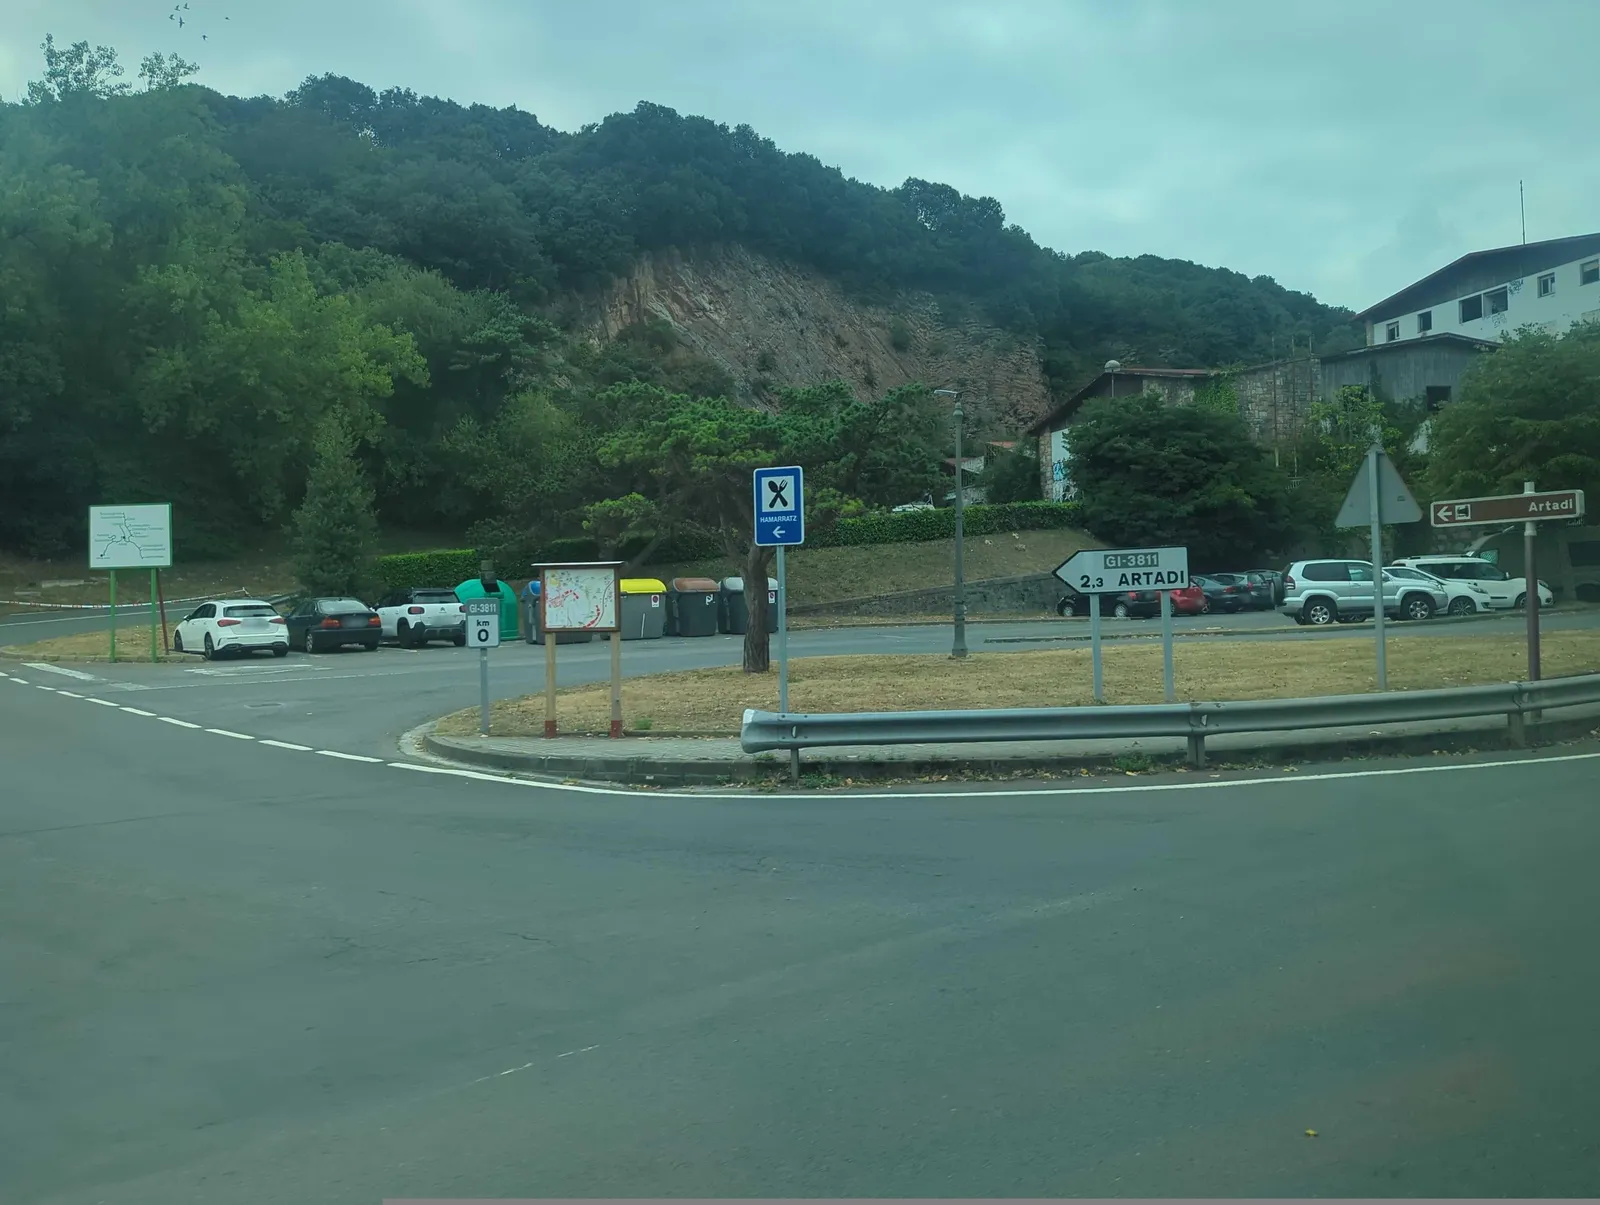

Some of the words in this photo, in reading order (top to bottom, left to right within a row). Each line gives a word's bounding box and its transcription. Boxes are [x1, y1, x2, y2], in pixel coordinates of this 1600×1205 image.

[1528, 498, 1573, 512] Artadi
[760, 515, 797, 523] HAMARRATZ
[1106, 554, 1158, 567] GI-3811
[1080, 574, 1104, 589] 2,3
[1118, 570, 1184, 587] ARTADI
[469, 603, 497, 613] GI-3811
[476, 619, 490, 627] km
